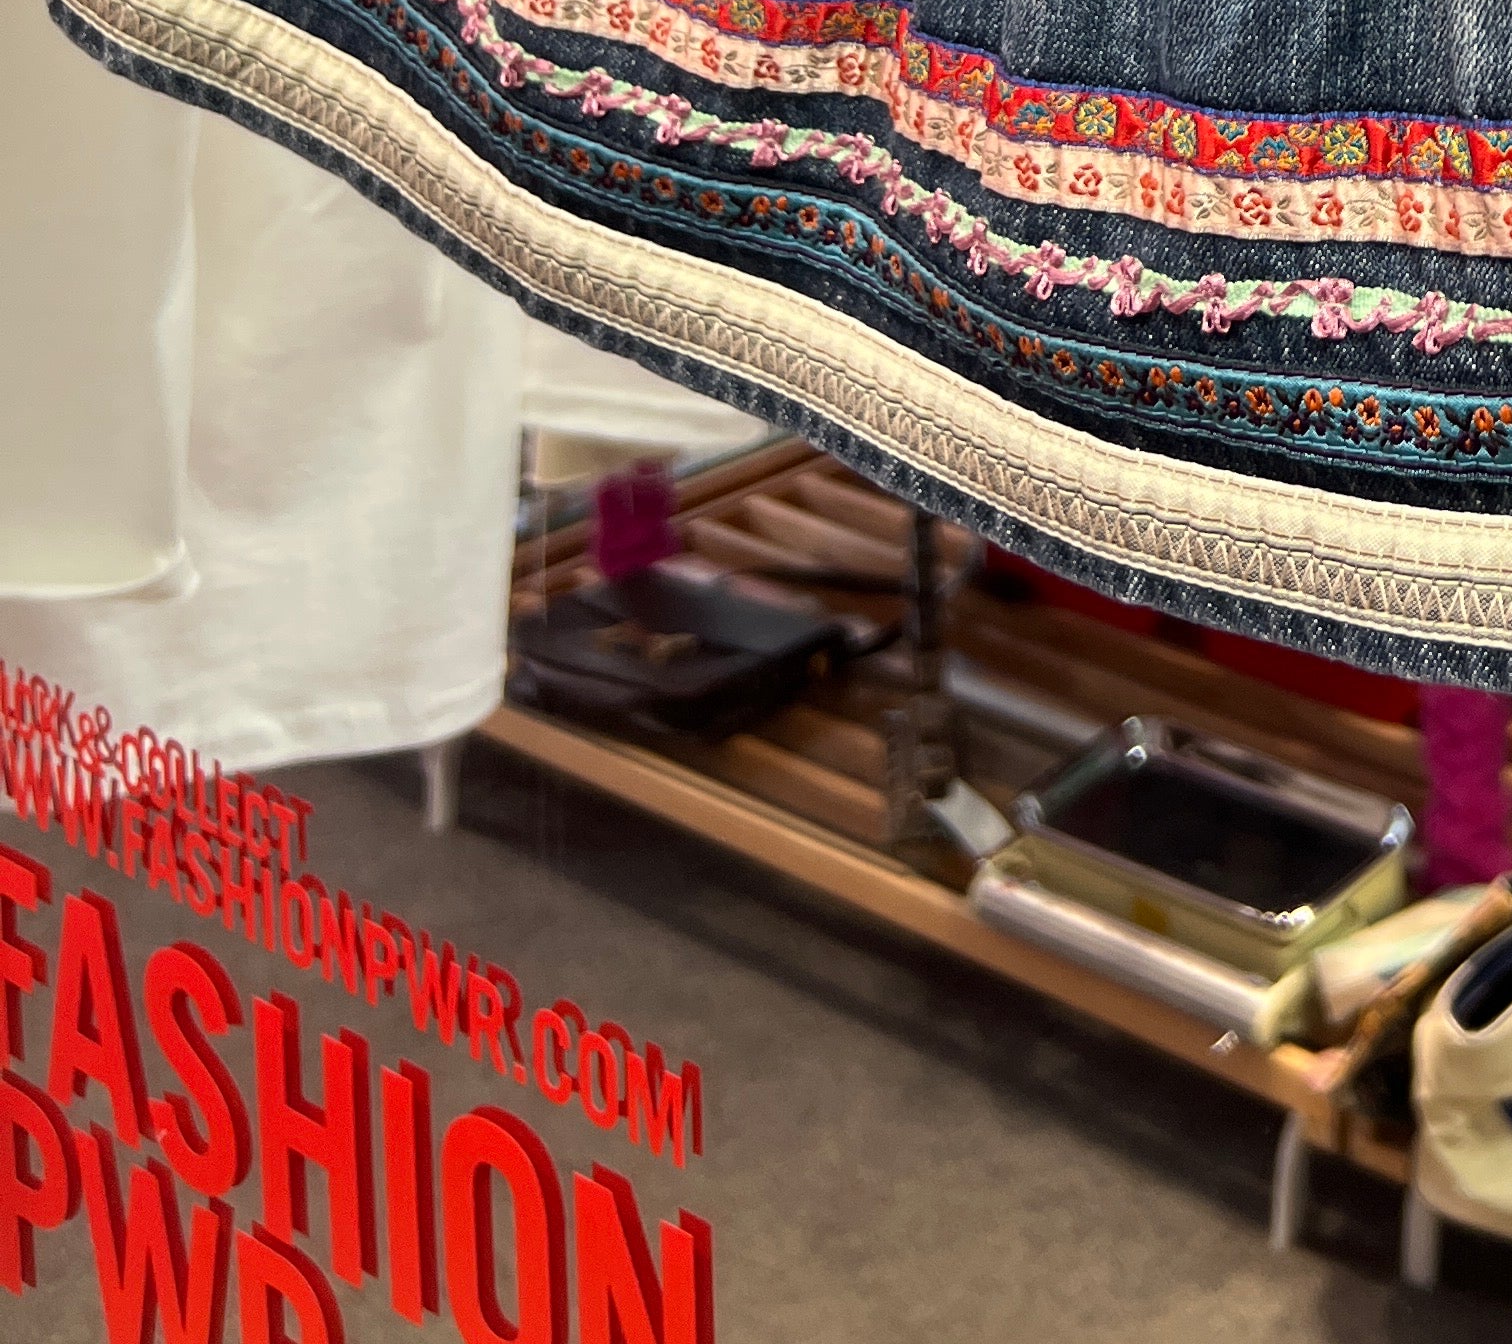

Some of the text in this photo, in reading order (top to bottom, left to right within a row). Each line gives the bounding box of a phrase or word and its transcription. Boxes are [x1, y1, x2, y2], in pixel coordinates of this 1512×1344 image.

[0, 730, 692, 1168] WW.FASHIONPWR.COM
[120, 728, 304, 874] COLLECT
[0, 848, 702, 1344] FASHION
